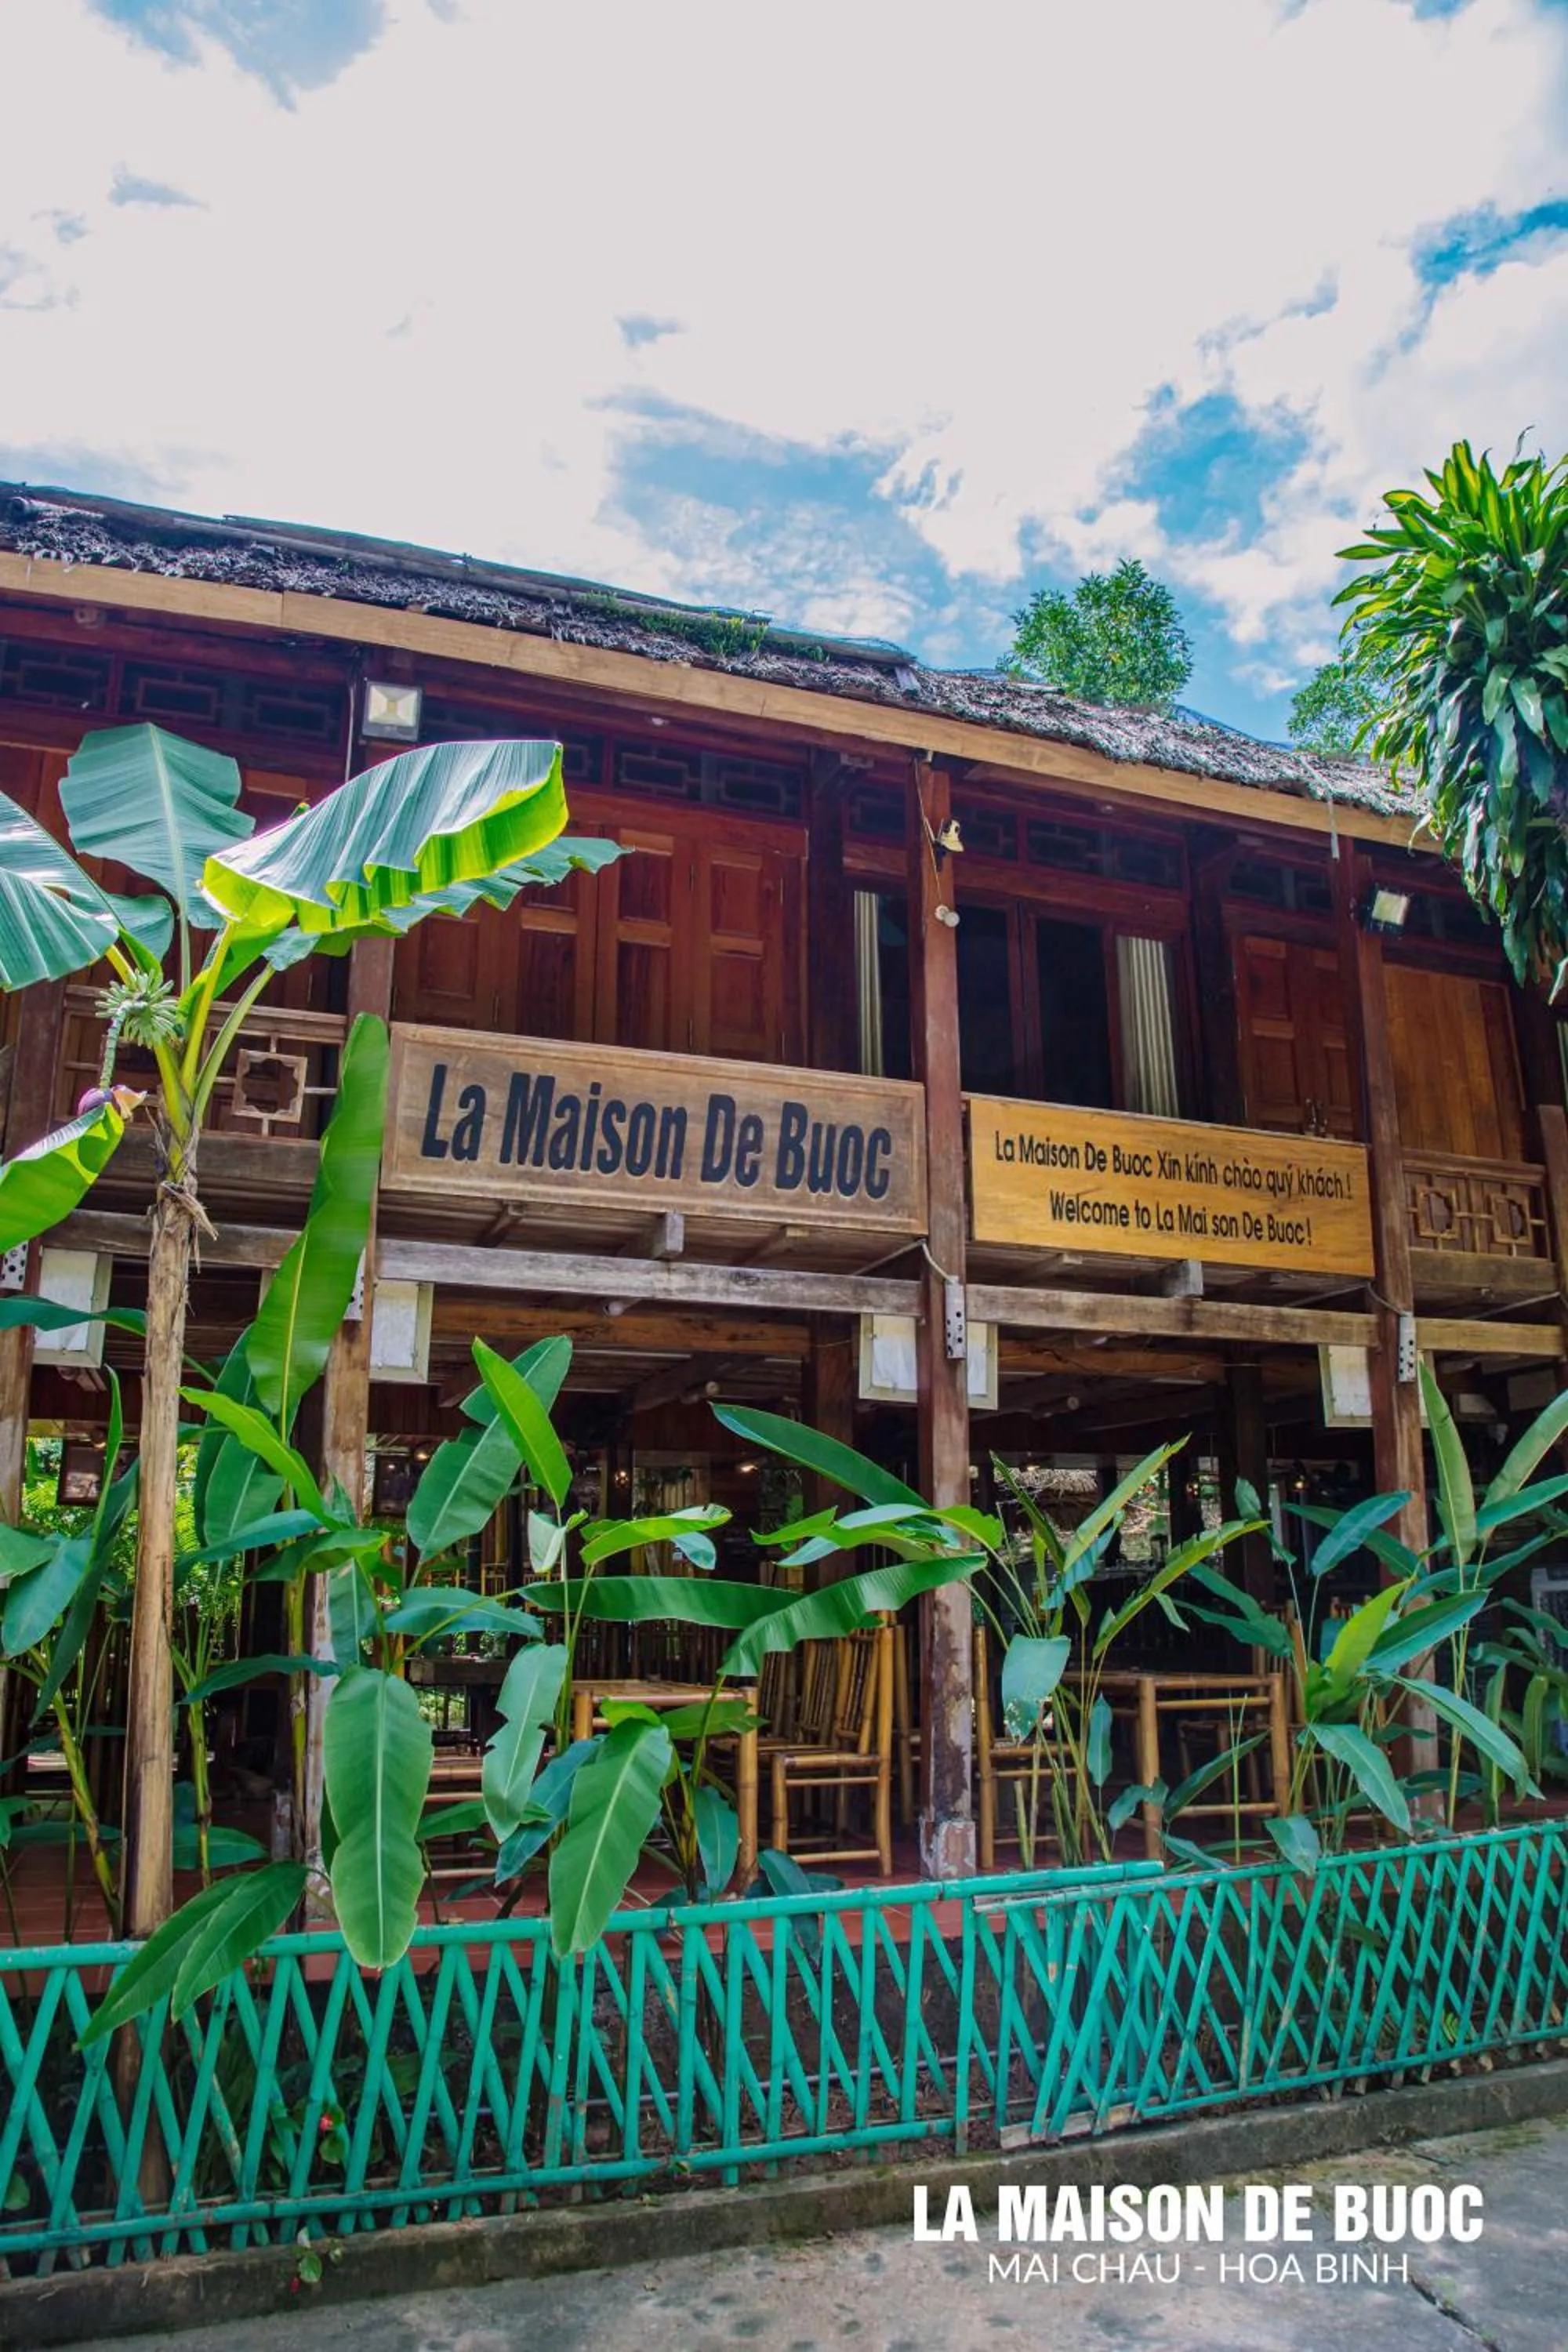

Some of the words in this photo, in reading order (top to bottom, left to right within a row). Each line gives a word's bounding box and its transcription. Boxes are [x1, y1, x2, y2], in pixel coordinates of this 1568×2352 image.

[421, 1064, 486, 1162] La
[499, 1072, 688, 1179] Maison
[701, 1094, 764, 1188] De
[775, 1102, 892, 1200] Buoc
[995, 1131, 1014, 1162] La
[1019, 1134, 1079, 1169] Maison
[1084, 1142, 1107, 1173] De
[1112, 1145, 1152, 1178] Buoc
[1156, 1150, 1181, 1181] Xin
[1185, 1151, 1218, 1185] kính
[1223, 1157, 1261, 1190] chào
[1266, 1163, 1294, 1199] quý
[1050, 1189, 1130, 1228] Welcome
[1135, 1200, 1151, 1229] to
[1156, 1201, 1174, 1232] La
[1243, 1211, 1263, 1241] De
[1267, 1214, 1312, 1247] Buoc!
